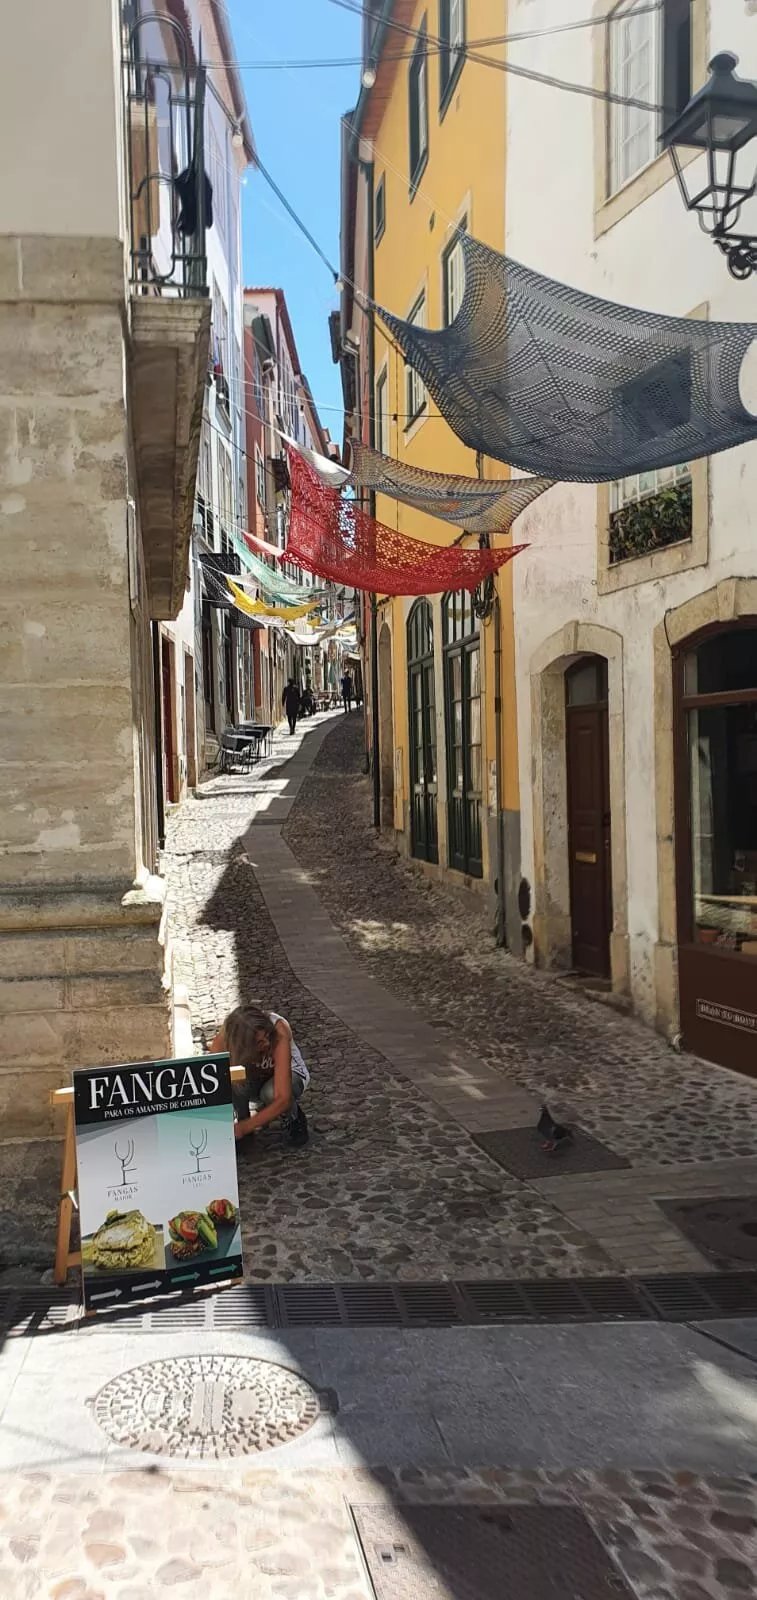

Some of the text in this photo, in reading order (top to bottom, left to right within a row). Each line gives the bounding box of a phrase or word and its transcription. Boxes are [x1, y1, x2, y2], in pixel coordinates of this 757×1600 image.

[88, 1064, 219, 1109] FANGAS
[104, 1098, 207, 1119] PARA OS AMANTES DE COMIDA
[182, 1174, 212, 1184] FANGAS
[106, 1186, 139, 1198] FANGAS
